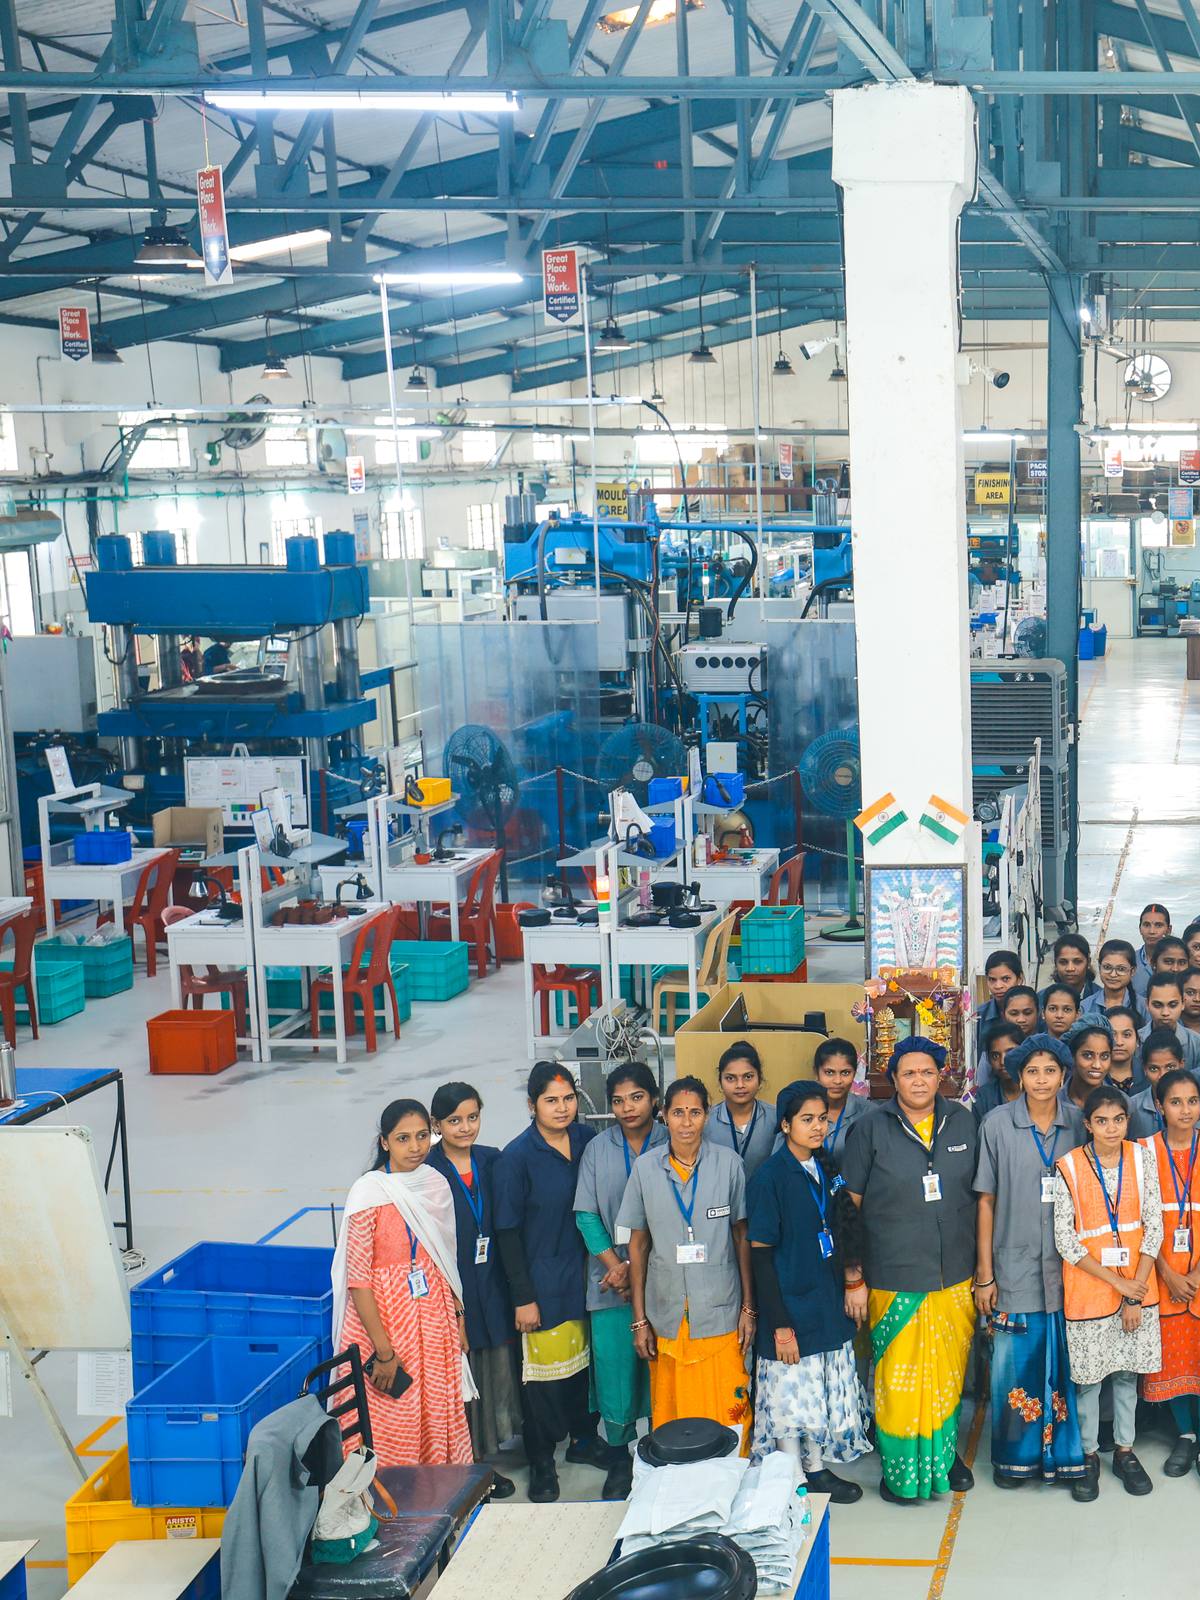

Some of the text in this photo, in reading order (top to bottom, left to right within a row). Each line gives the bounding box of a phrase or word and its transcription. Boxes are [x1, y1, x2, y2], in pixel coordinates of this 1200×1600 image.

[200, 174, 215, 189] Great
[201, 191, 215, 205] Place
[546, 254, 569, 264] Great
[547, 264, 567, 273] Place
[547, 274, 556, 282] To
[549, 296, 576, 305] Certified
[62, 310, 80, 318] Great
[597, 489, 627, 501] MOULD
[986, 491, 1004, 500] AREA
[167, 1517, 195, 1525] ARISTO
